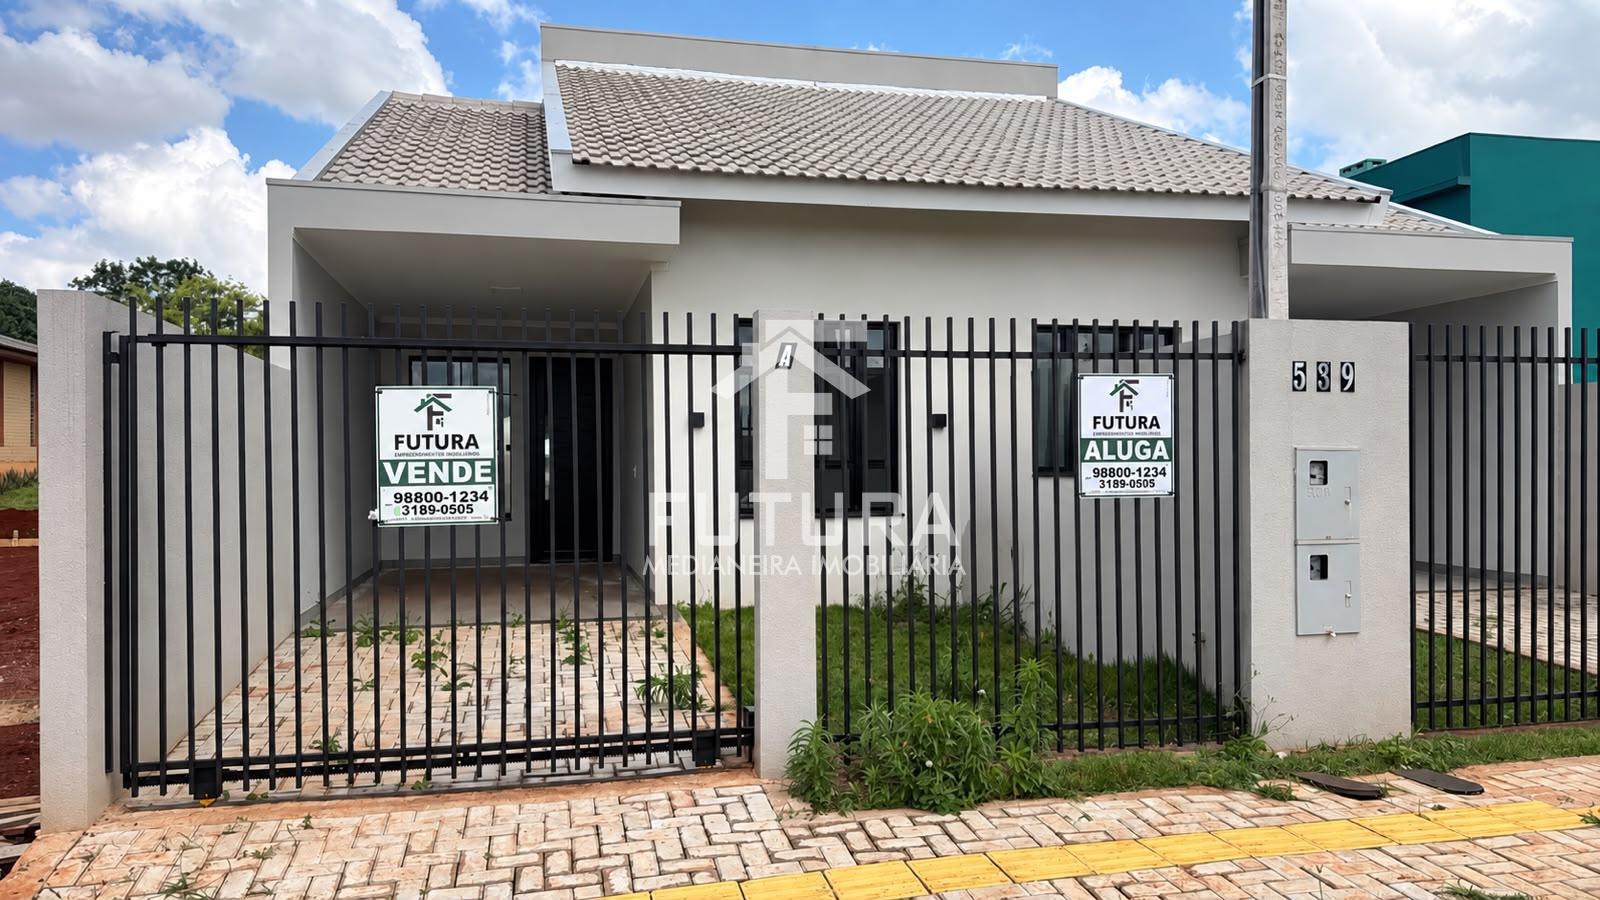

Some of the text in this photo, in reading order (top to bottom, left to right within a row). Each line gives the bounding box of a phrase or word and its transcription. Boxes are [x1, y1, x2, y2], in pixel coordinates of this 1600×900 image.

[1292, 361, 1355, 391] 539
[1093, 416, 1161, 430] FUTURA
[394, 434, 479, 450] FUTURA
[1084, 440, 1170, 460] ALUGA
[383, 461, 493, 484] VENDE
[1092, 467, 1167, 478] 98800-1234
[1099, 479, 1155, 489] 3189-0505
[393, 490, 489, 504] 98800-1234
[402, 504, 474, 516] 3189-0505
